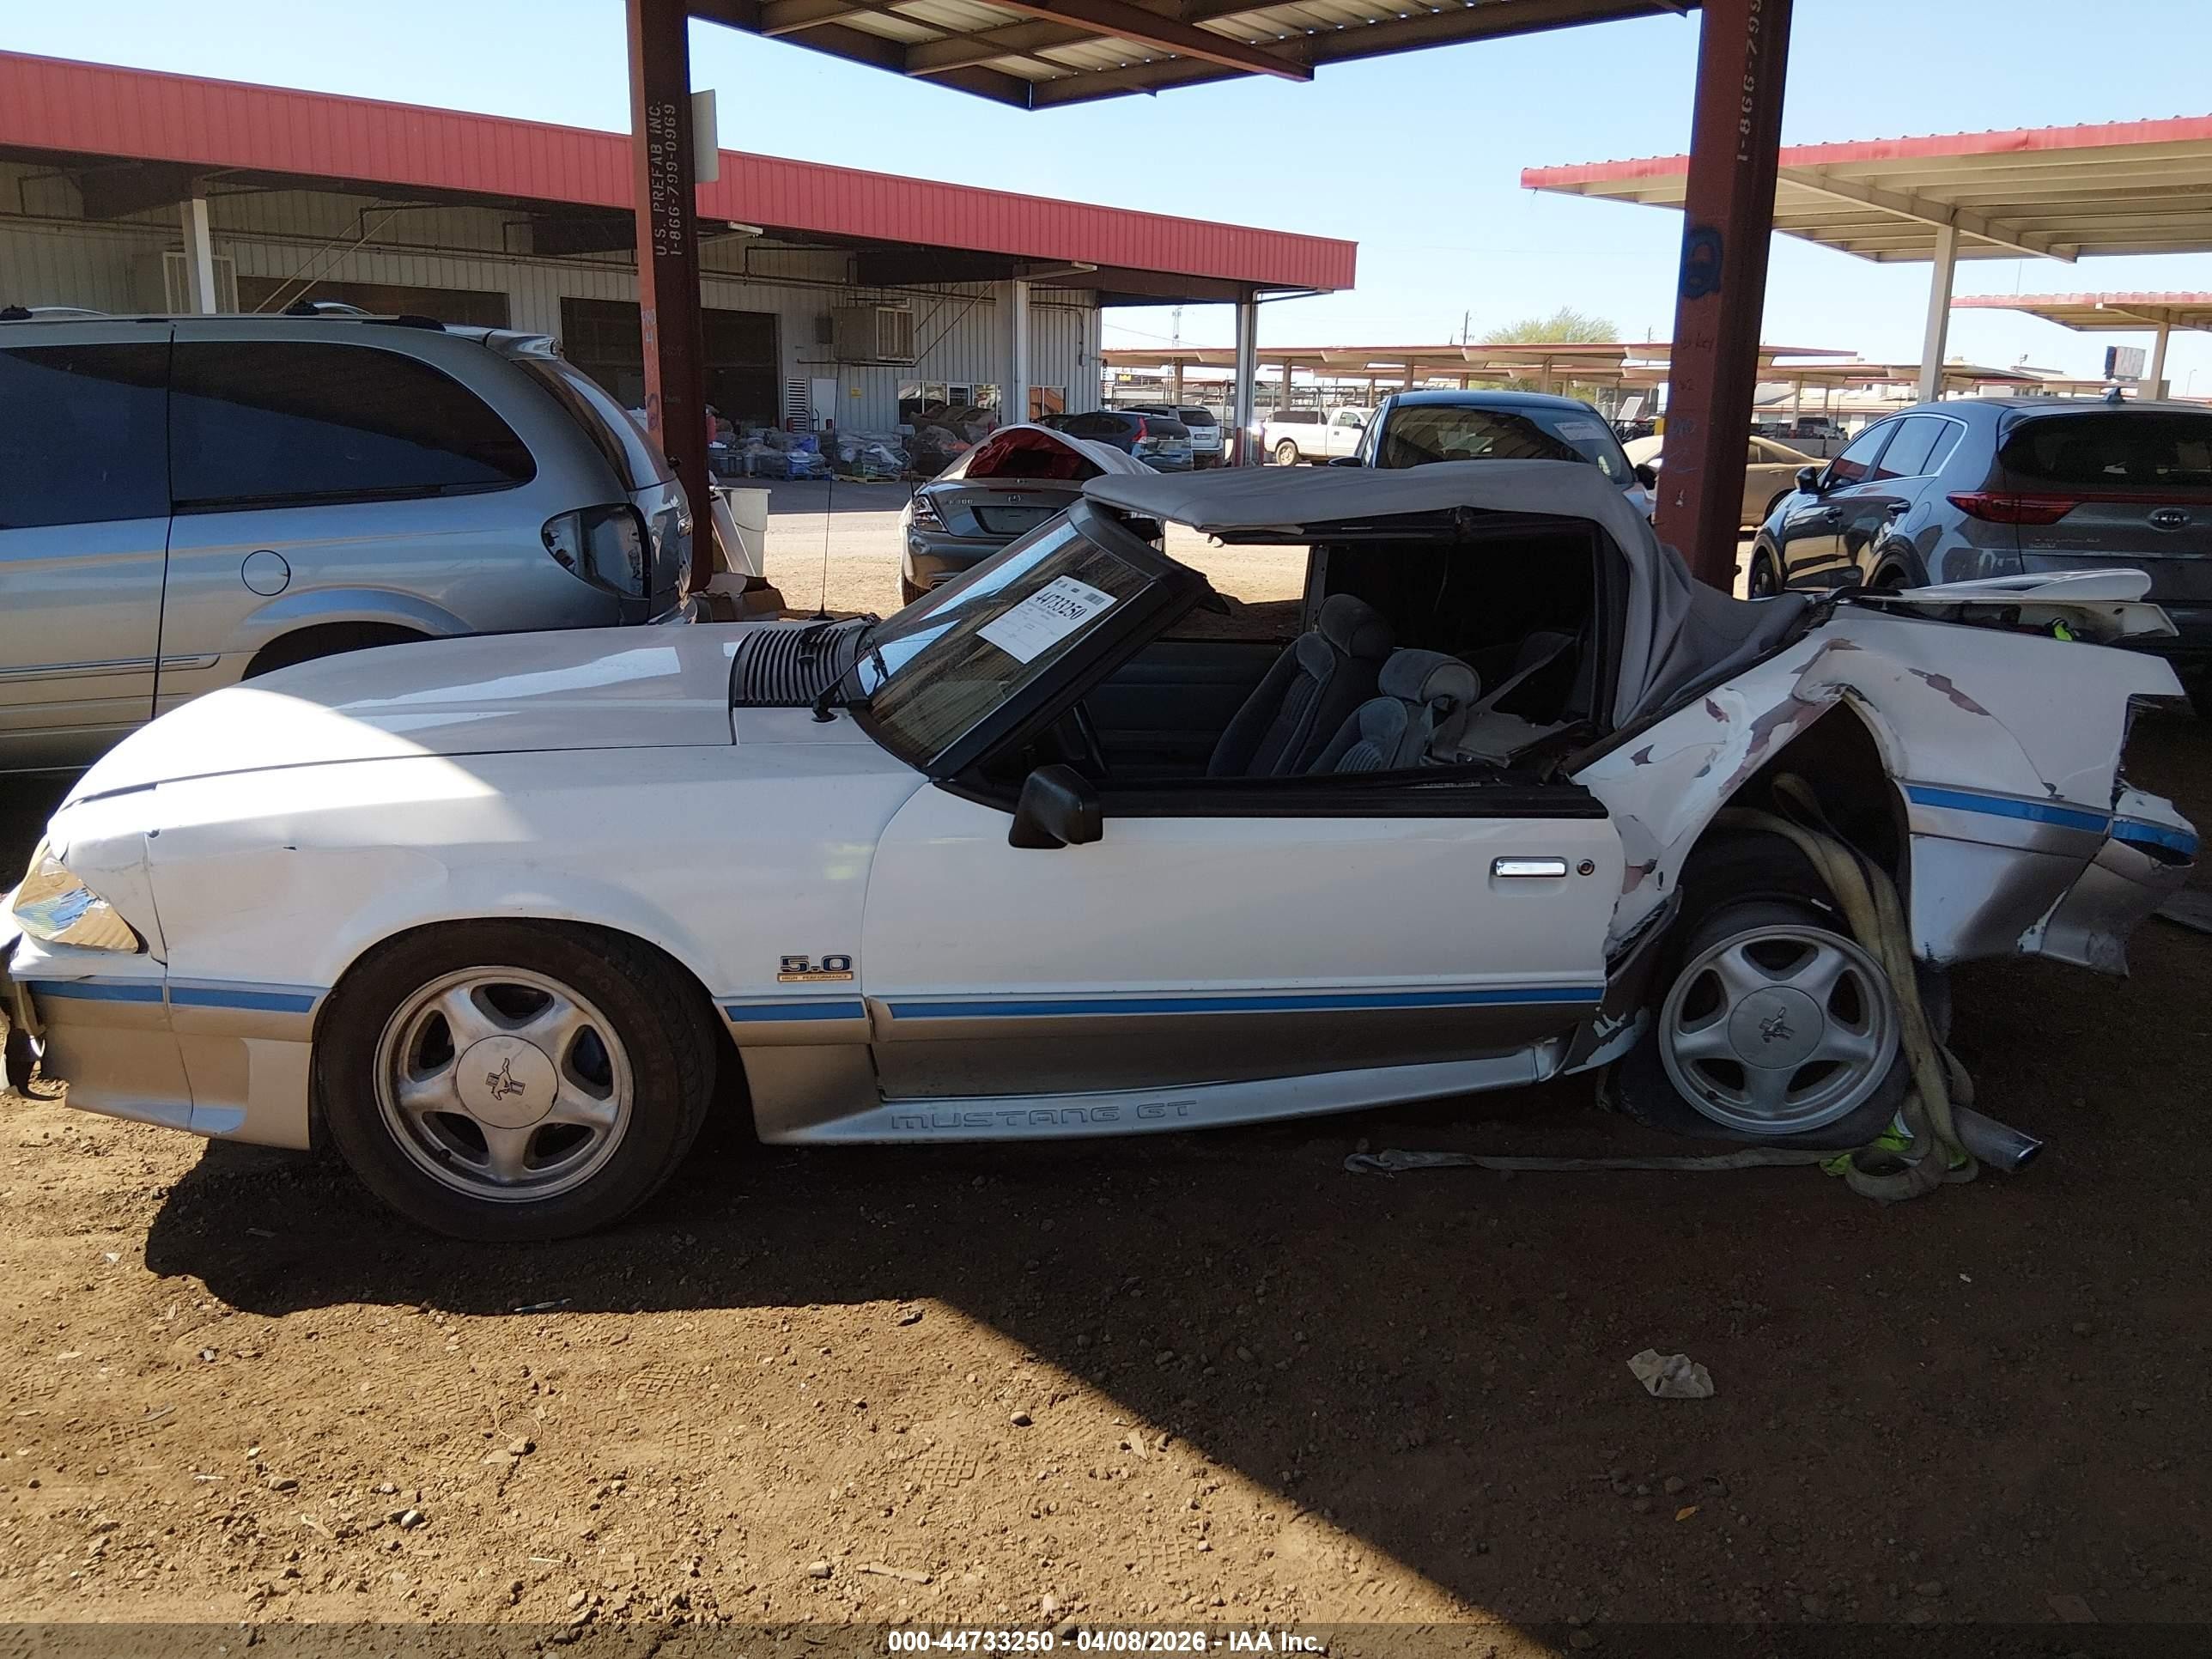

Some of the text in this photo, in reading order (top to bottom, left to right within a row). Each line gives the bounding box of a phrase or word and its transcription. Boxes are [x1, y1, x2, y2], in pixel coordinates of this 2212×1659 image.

[650, 143, 665, 213] PREFAB
[664, 104, 683, 255] 1-866-799-0969
[654, 222, 668, 257] U.S.
[1035, 591, 1088, 620] 44733250
[781, 955, 852, 973] 5.0
[891, 1100, 1197, 1130] MUSTANG GT
